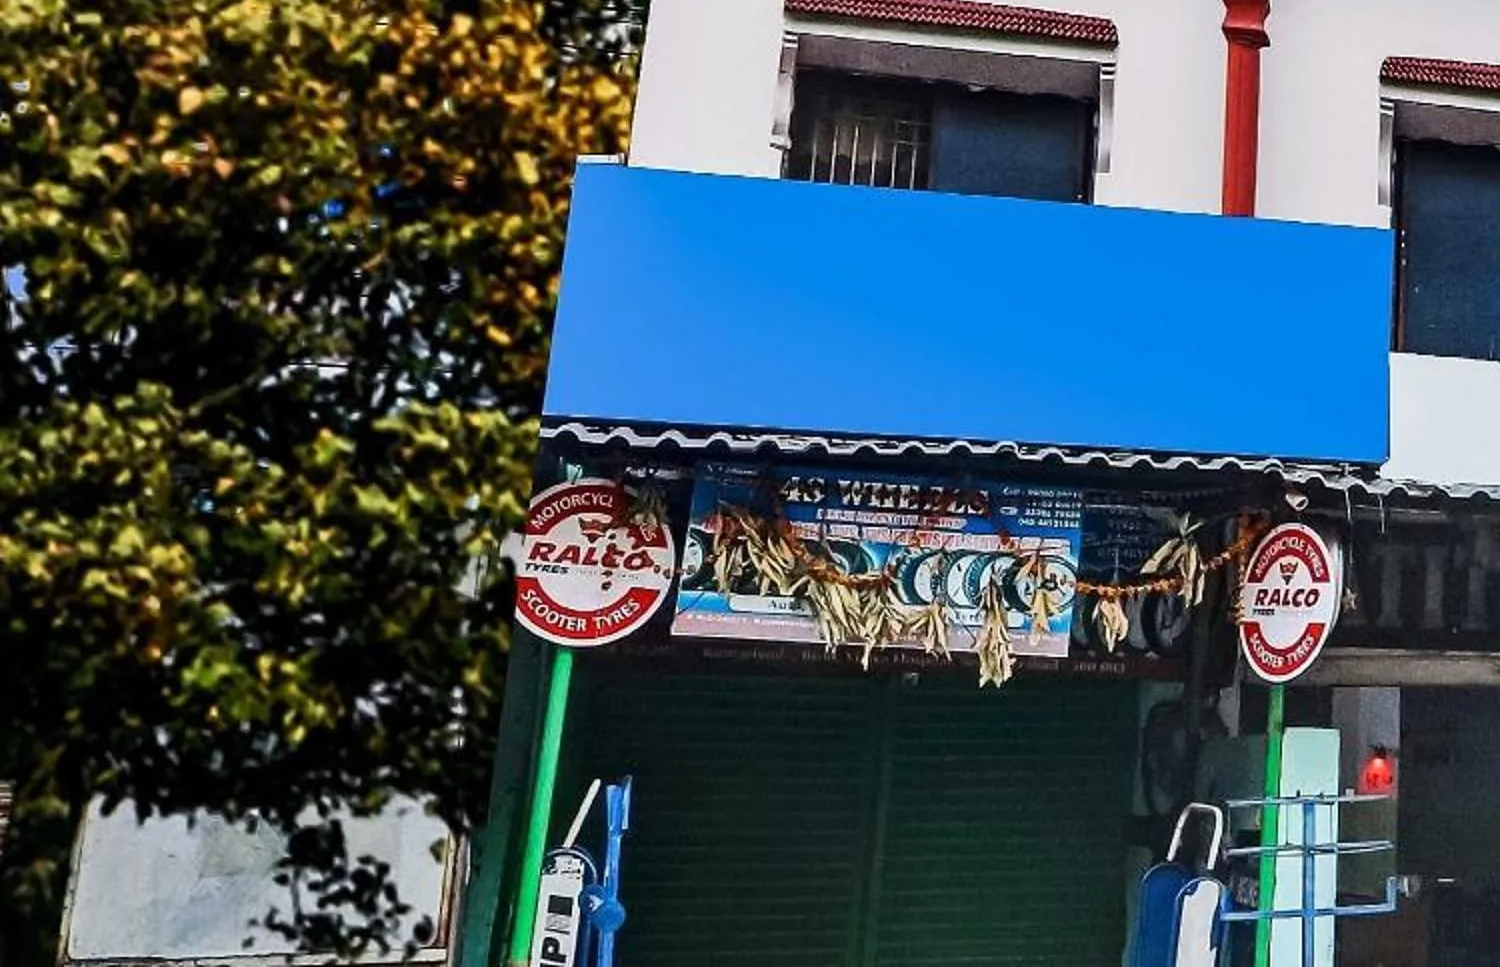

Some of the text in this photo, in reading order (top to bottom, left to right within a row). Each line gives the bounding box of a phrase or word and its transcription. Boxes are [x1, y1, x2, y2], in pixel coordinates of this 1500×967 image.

[525, 562, 570, 575] TYRES
[1255, 536, 1305, 579] MOTORCYCLE
[521, 588, 588, 633] SCOOTER
[592, 597, 642, 633] TYRES
[1253, 588, 1321, 609] RALCO
